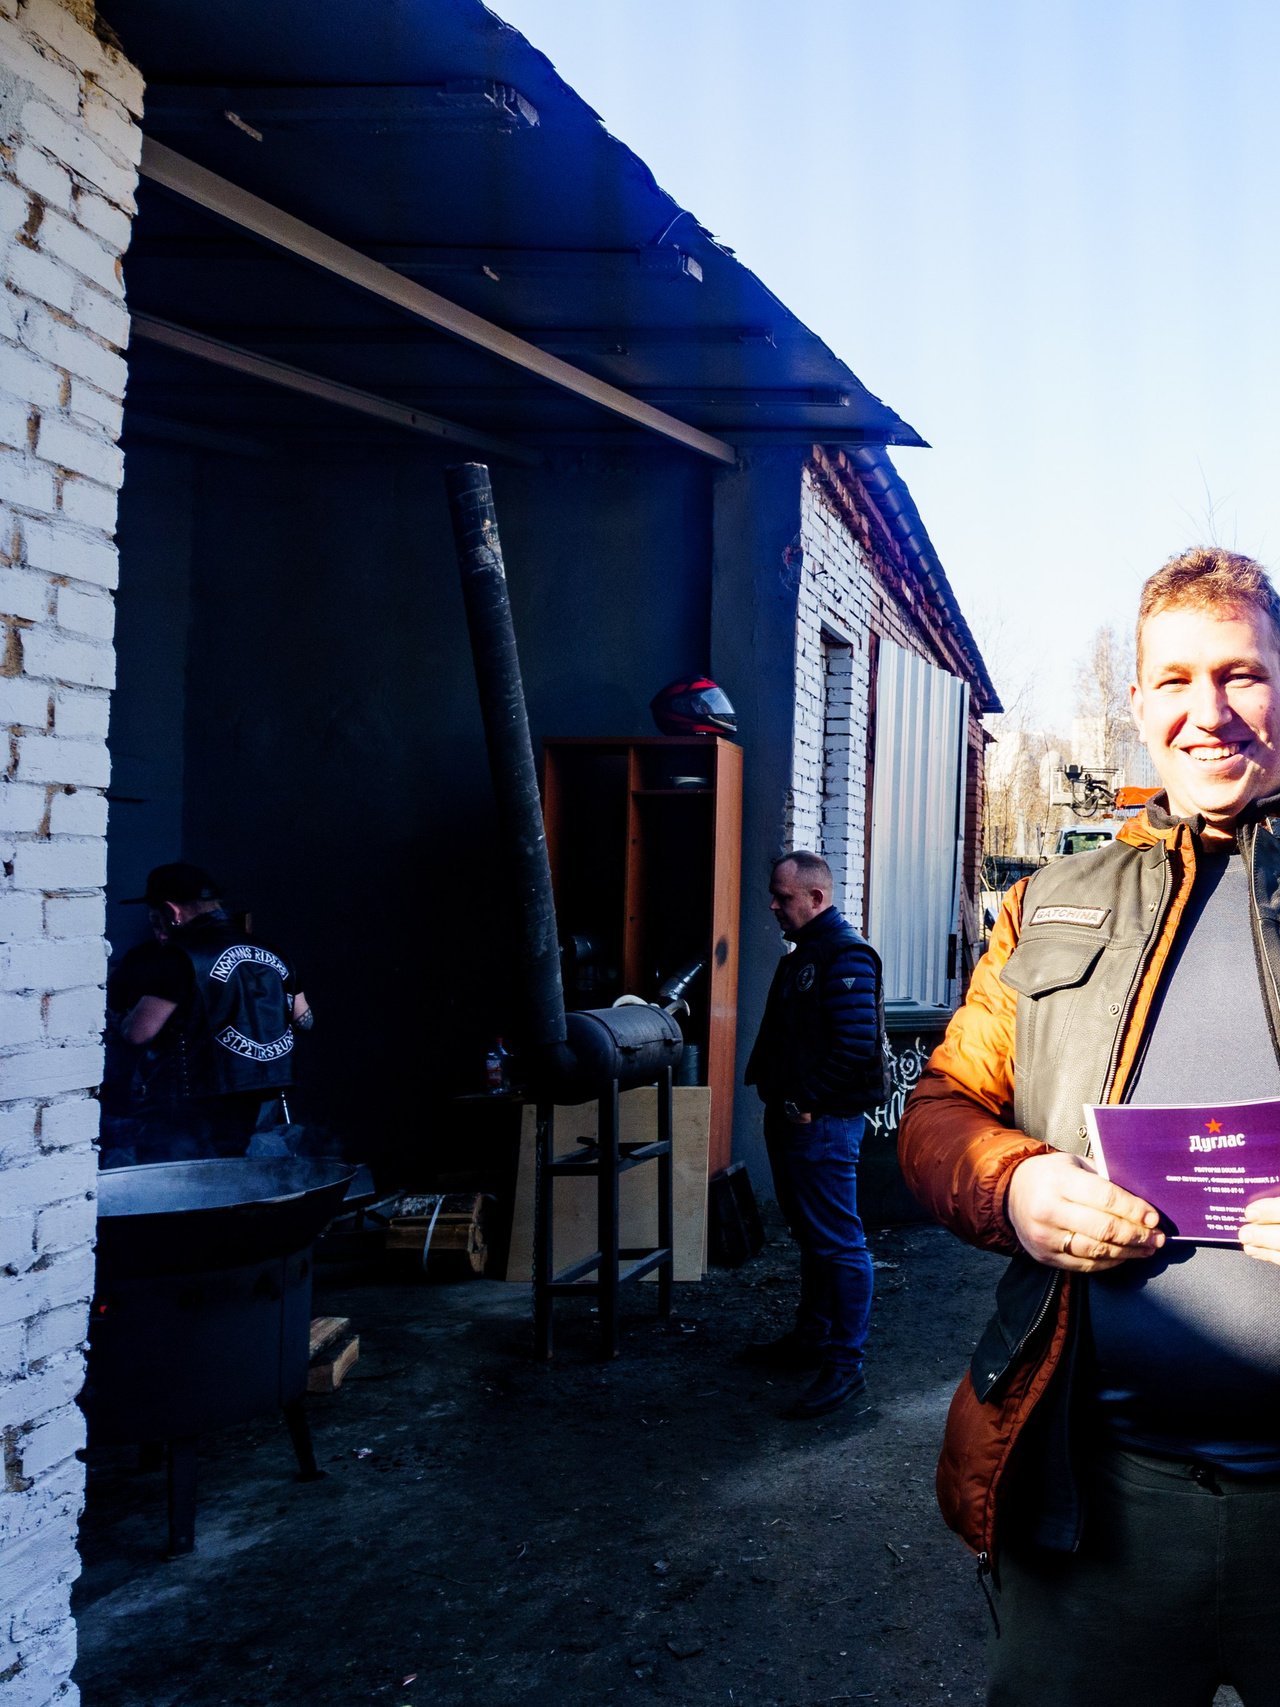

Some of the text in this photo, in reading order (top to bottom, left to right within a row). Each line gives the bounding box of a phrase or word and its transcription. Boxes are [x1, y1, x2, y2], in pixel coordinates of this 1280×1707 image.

[1036, 909, 1098, 922] GATCHINA
[213, 946, 288, 979] NORMANS RIDERS
[1189, 1133, 1245, 1152] Дуглас
